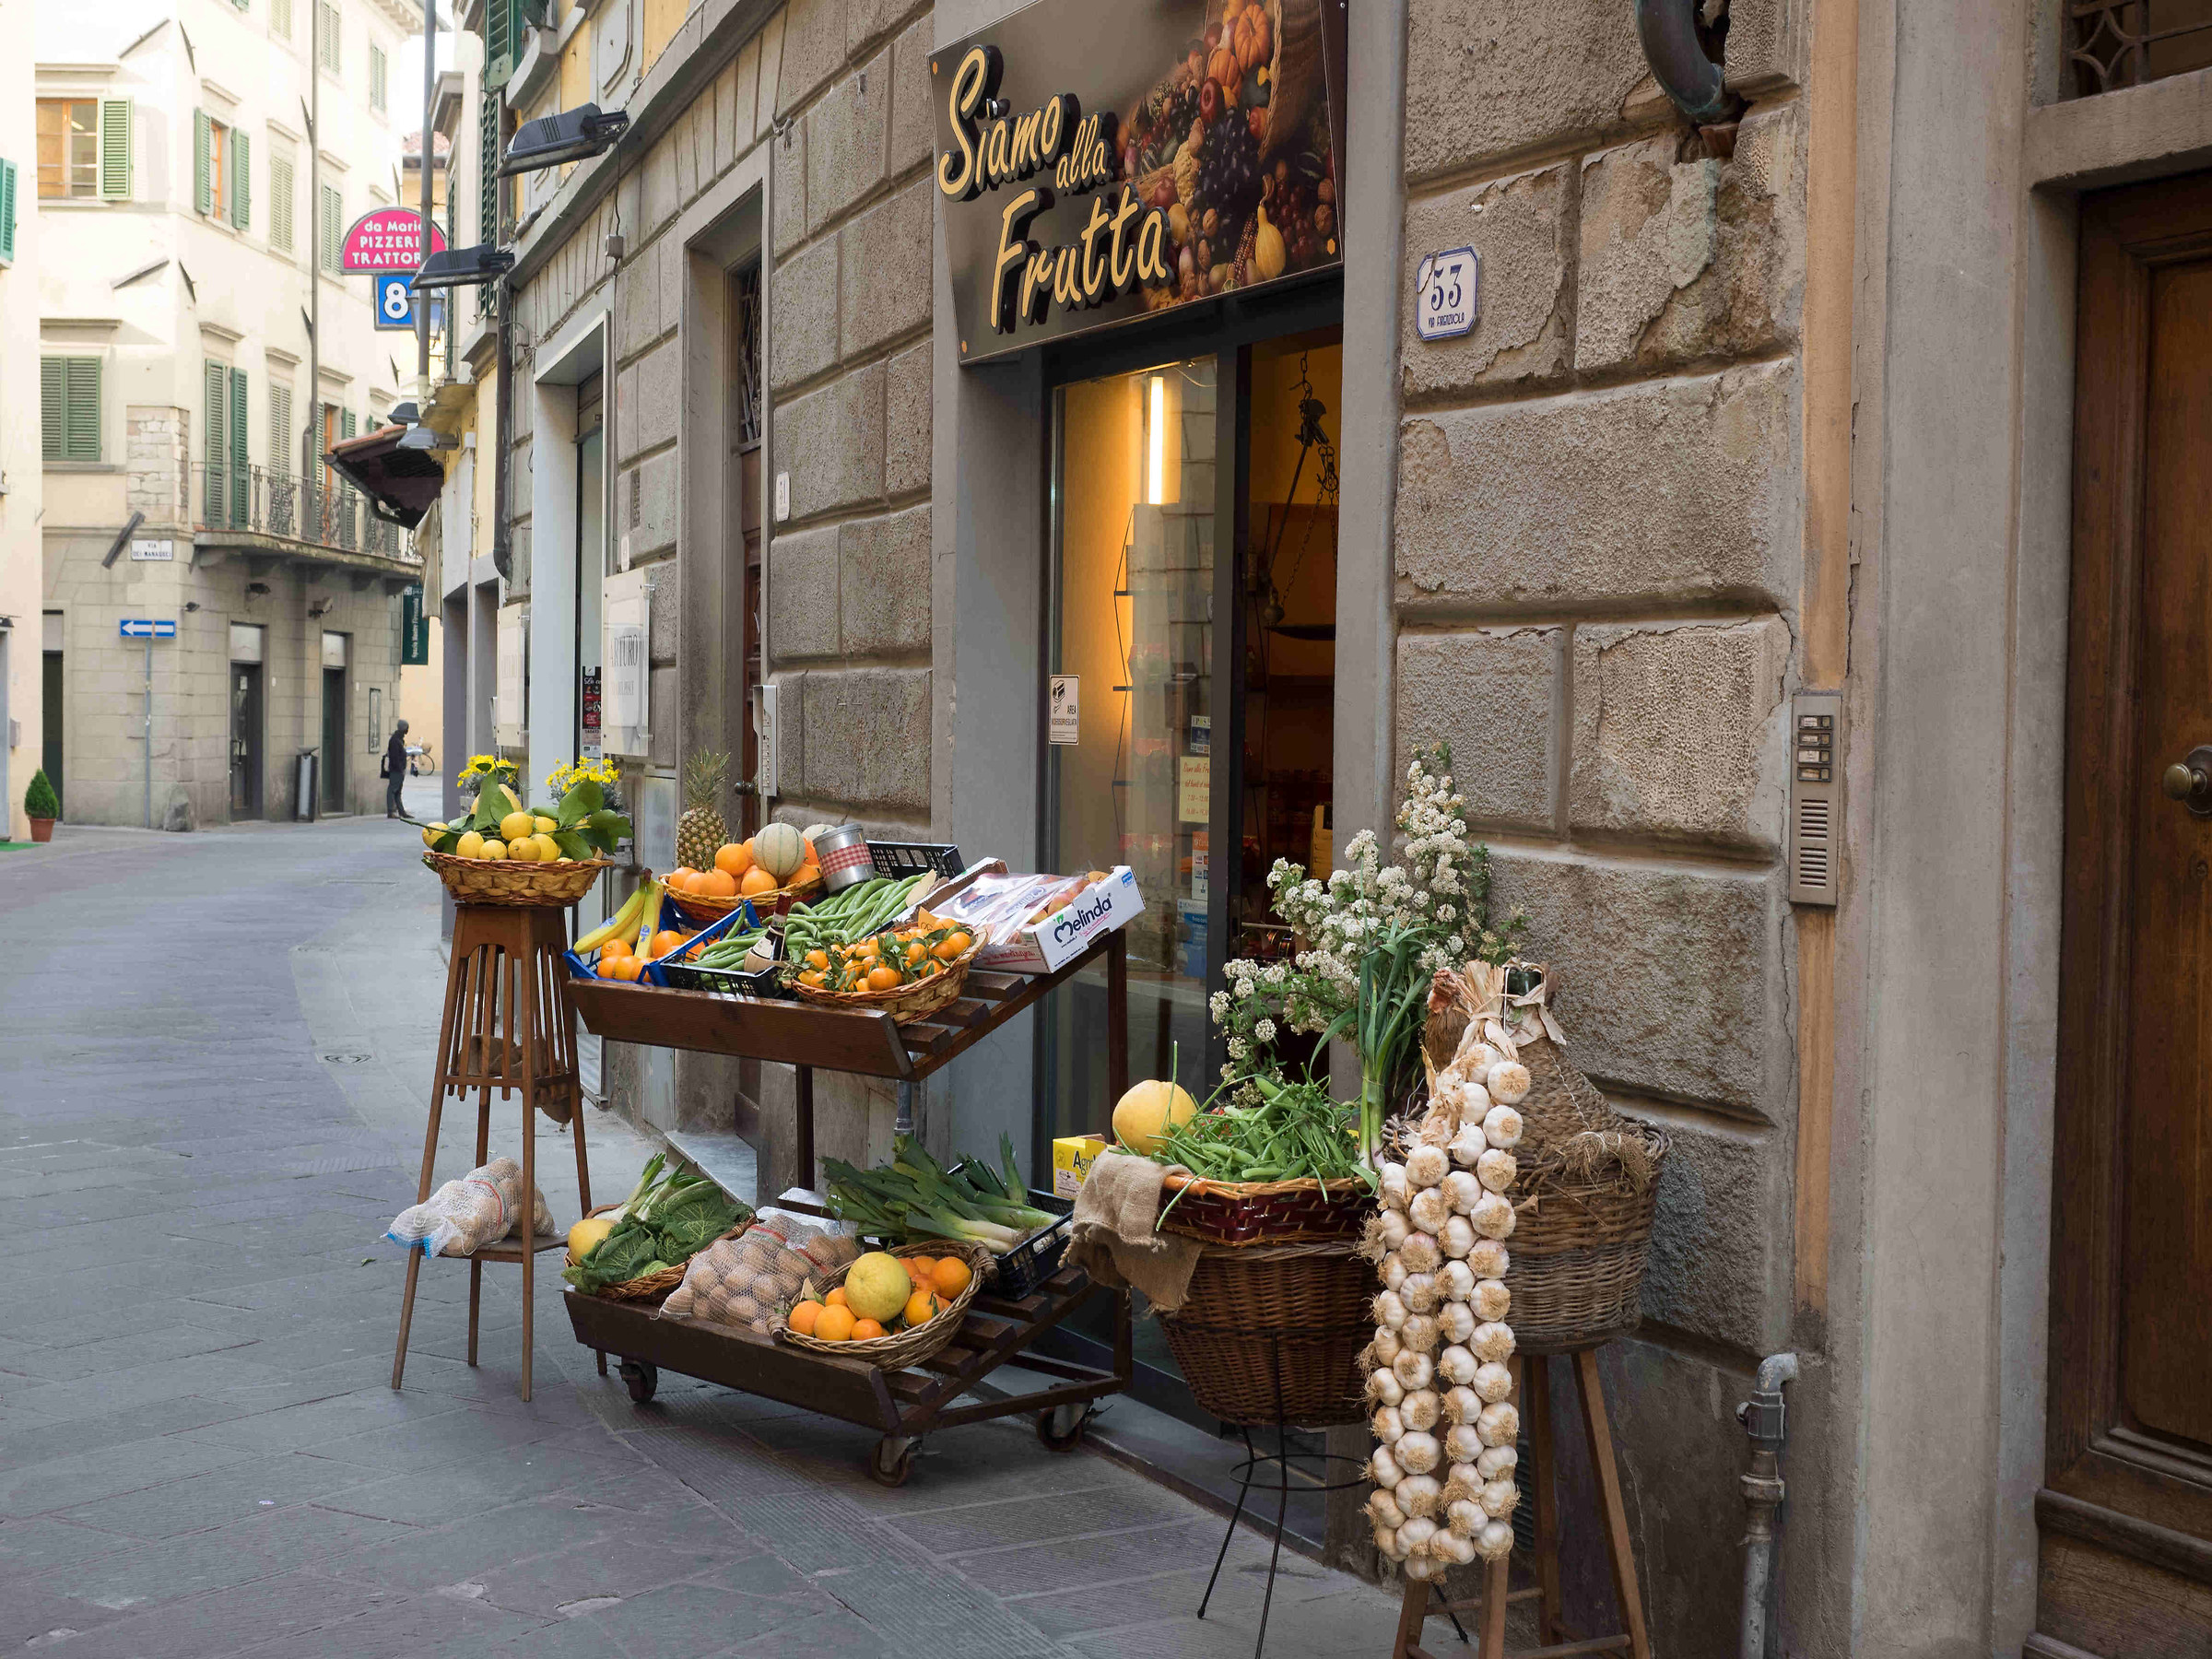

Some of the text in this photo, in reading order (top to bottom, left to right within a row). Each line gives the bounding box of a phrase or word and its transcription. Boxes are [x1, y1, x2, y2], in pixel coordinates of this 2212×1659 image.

[937, 45, 1109, 199] Siamo alla
[359, 235, 421, 249] PIZZERI
[364, 219, 382, 232] da
[352, 252, 421, 265] TRATTOR
[990, 183, 1168, 331] Frutta
[1430, 264, 1464, 312] 53
[610, 633, 639, 668] ARTURO
[1066, 704, 1077, 714] AREA
[1053, 897, 1112, 944] Melinda
